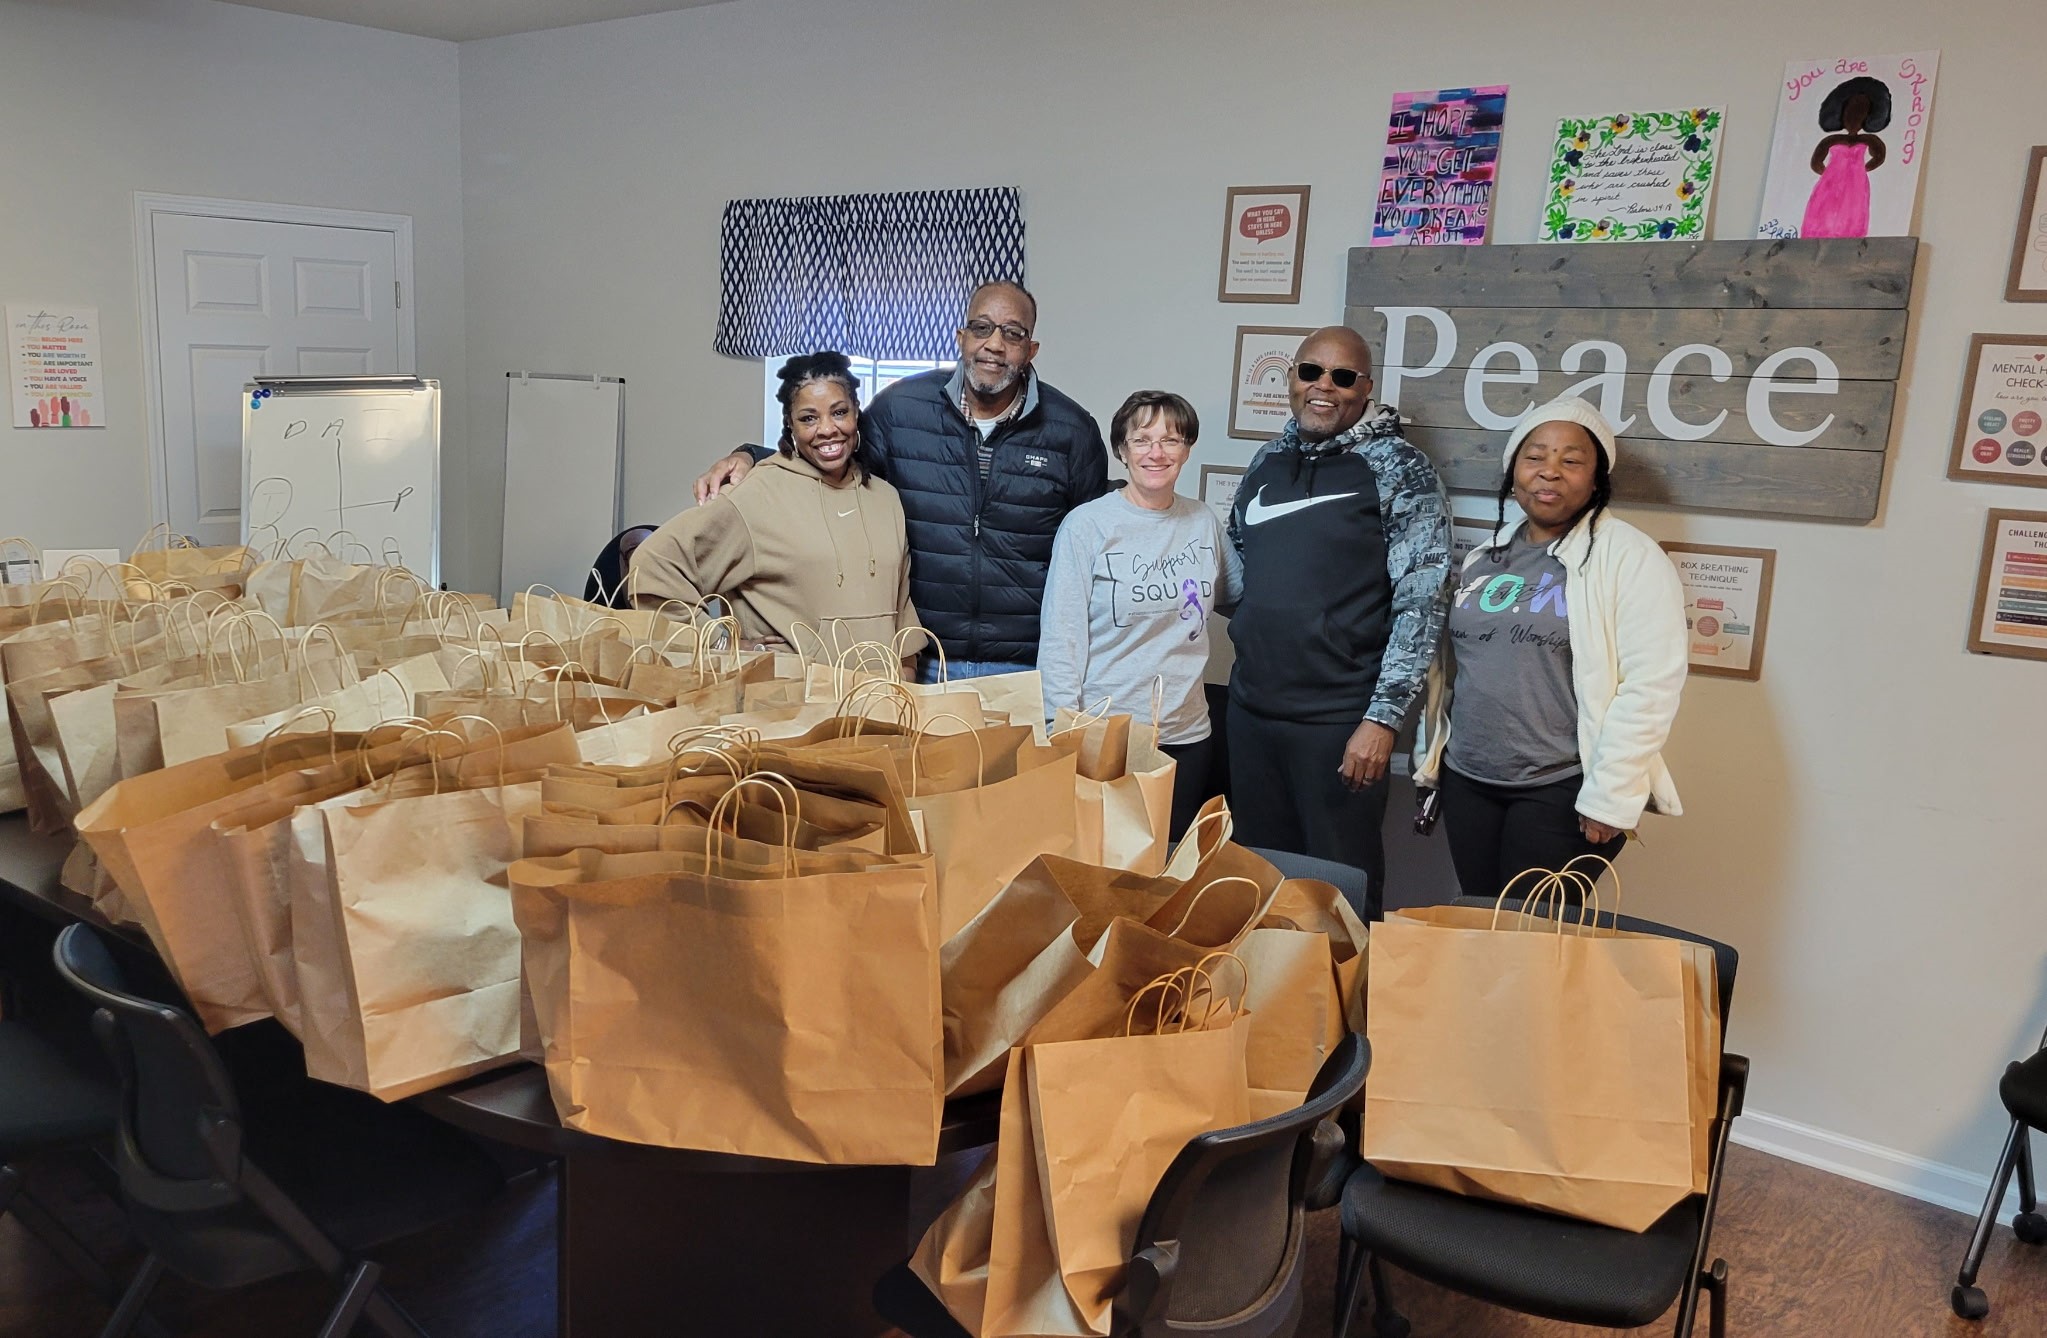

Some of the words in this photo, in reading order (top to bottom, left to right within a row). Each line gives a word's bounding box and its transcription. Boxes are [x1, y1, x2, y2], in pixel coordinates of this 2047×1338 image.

[1787, 68, 1826, 101] you
[1389, 111, 1410, 139] I
[1419, 107, 1478, 138] HOPE
[1649, 143, 1675, 153] close
[1397, 146, 1430, 175] YOU
[1436, 145, 1479, 175] GET
[1595, 157, 1616, 167] the
[1380, 207, 1413, 230] YOU
[1410, 229, 1463, 245] ABOUT
[1374, 306, 1839, 447] Peace
[1992, 363, 2036, 374] MENTAL
[1680, 561, 1698, 569] BOX
[1700, 562, 1749, 574] BREATHING
[1689, 573, 1738, 584] TECHNIQUE
